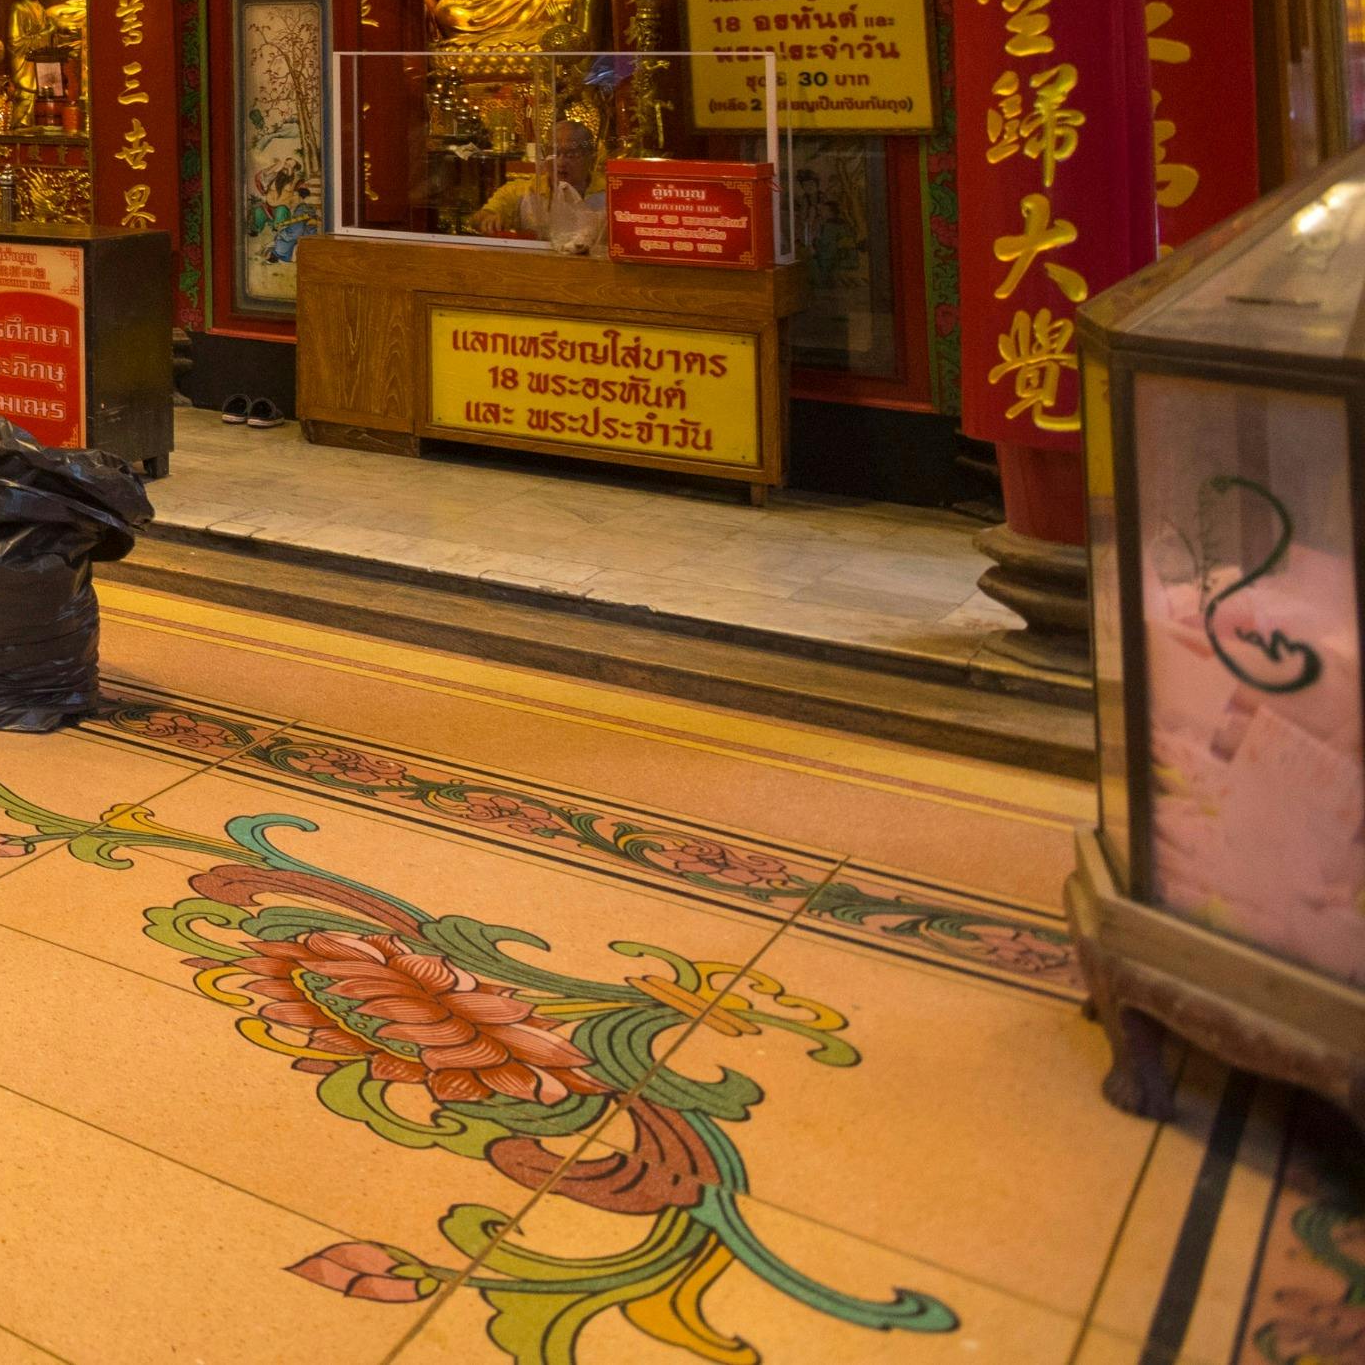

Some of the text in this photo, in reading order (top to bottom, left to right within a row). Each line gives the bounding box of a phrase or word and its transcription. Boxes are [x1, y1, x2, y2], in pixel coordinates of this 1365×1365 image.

[713, 4, 895, 33] 18 อรหันต์ และ
[798, 71, 828, 87] 30
[835, 72, 870, 86] บาท
[750, 98, 763, 112] 2
[452, 329, 729, 378] แลกเหรียญใส่บาตร
[487, 365, 687, 411] 18 พระอรหันต์
[465, 399, 714, 452] และ พระประจำวัน
